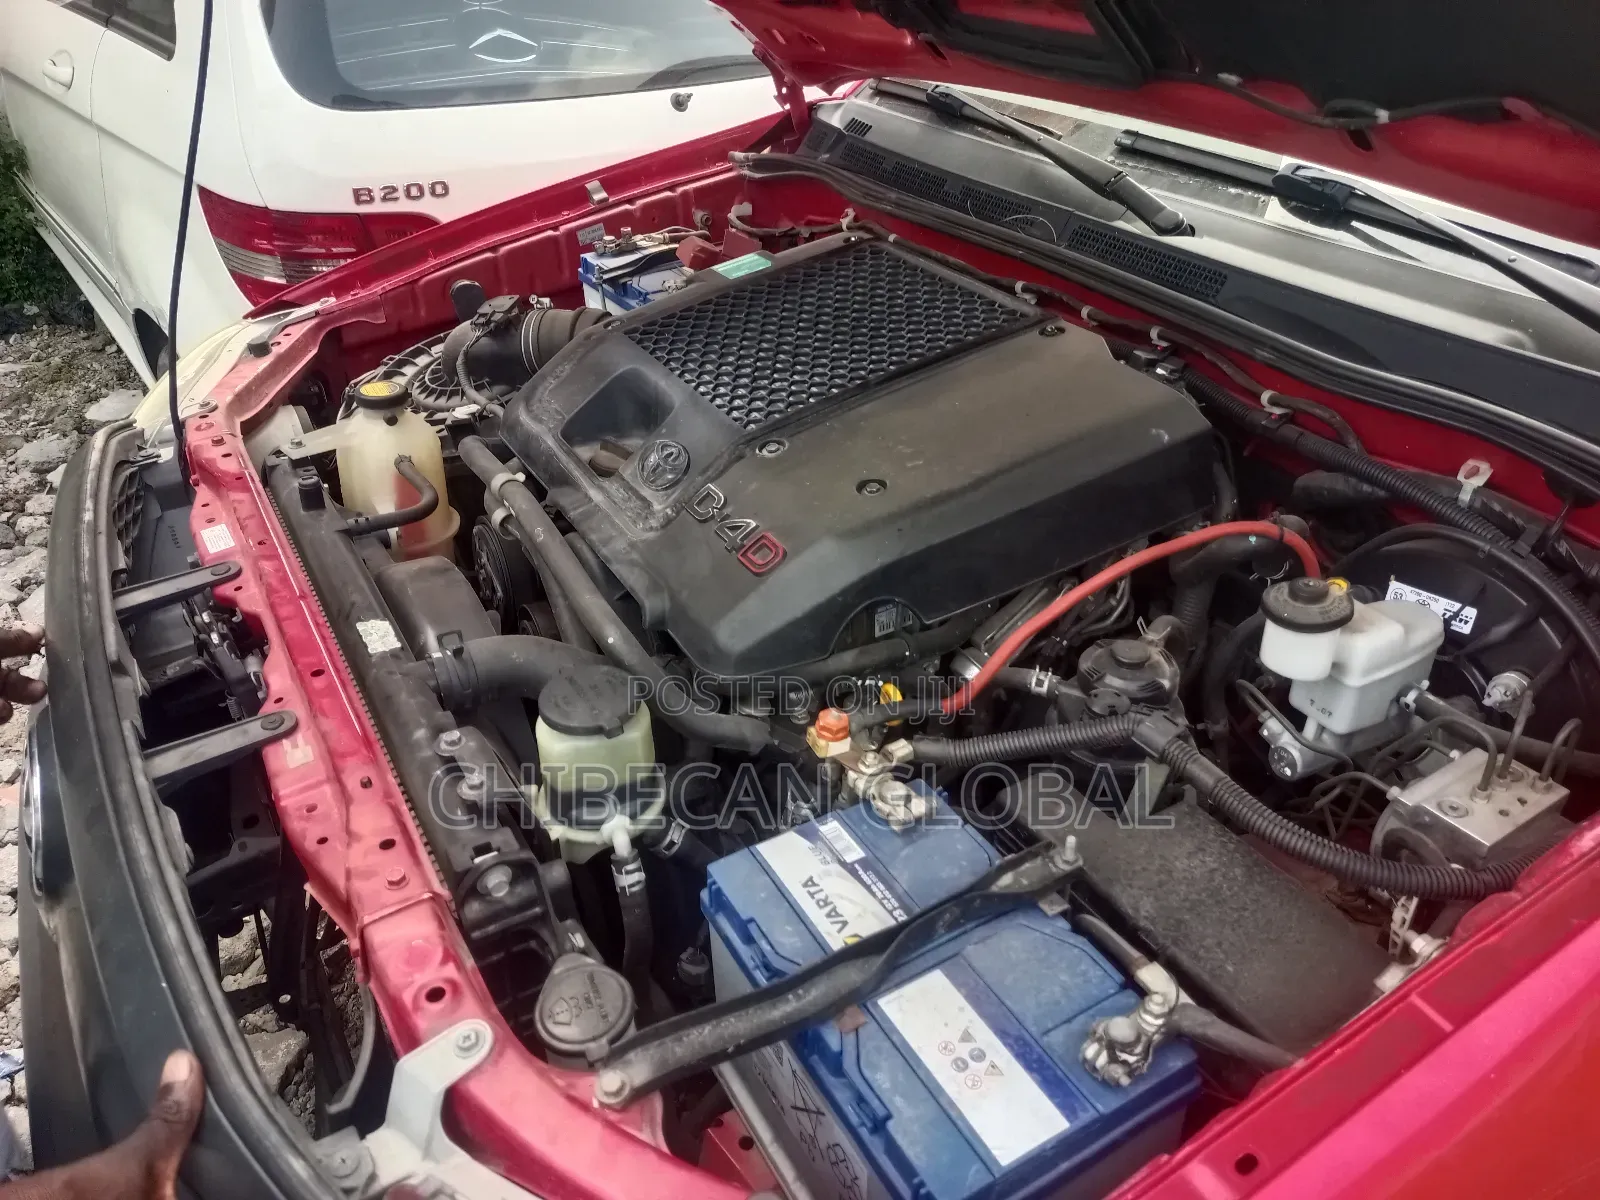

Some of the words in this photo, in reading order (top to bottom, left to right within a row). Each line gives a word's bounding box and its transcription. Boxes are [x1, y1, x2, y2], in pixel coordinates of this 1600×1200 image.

[352, 180, 450, 206] B200
[807, 844, 830, 867] BLUE
[801, 874, 849, 934] VARTA
